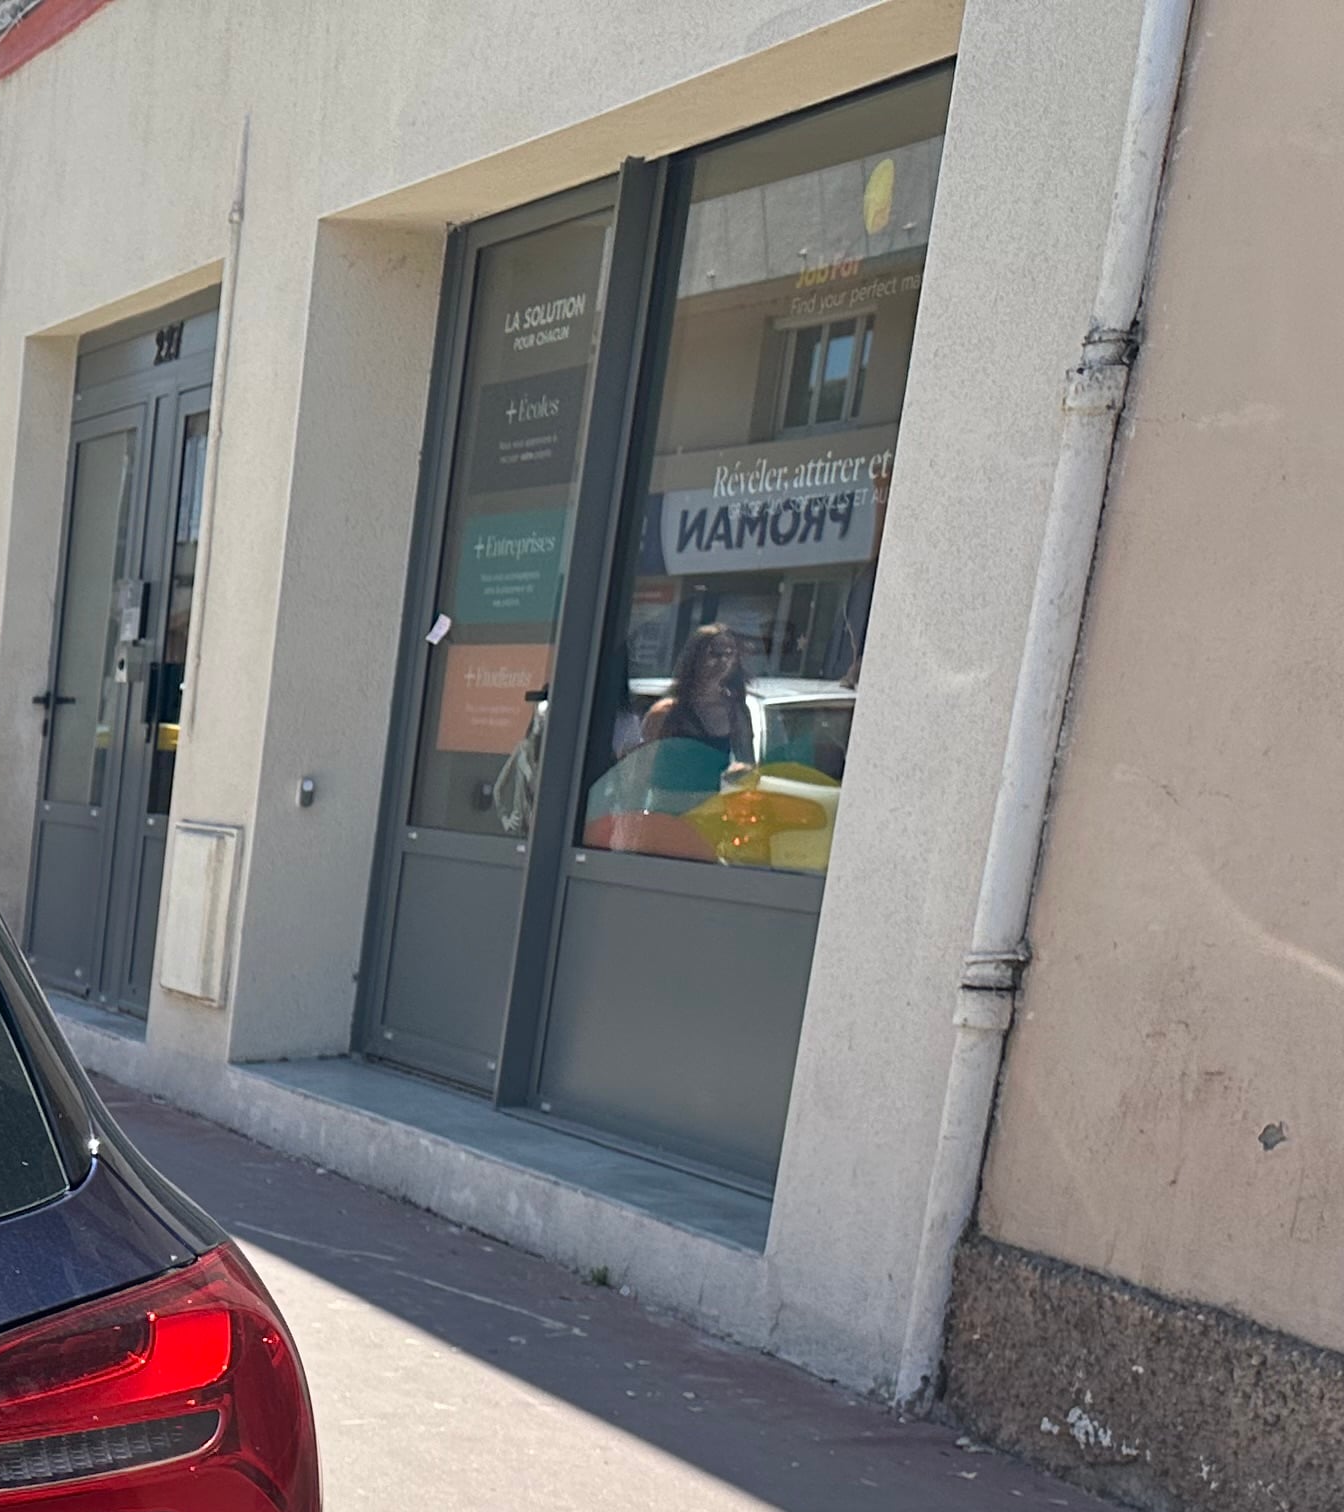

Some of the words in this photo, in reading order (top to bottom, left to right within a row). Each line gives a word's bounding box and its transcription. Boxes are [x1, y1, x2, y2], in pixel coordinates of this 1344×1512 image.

[504, 311, 520, 333] LA
[523, 293, 586, 329] SOLUTION
[818, 289, 847, 314] your
[849, 277, 898, 308] perfect
[713, 460, 789, 498] Révéler,
[792, 450, 866, 490] attirer
[868, 449, 893, 480] et
[853, 488, 869, 507] ET
